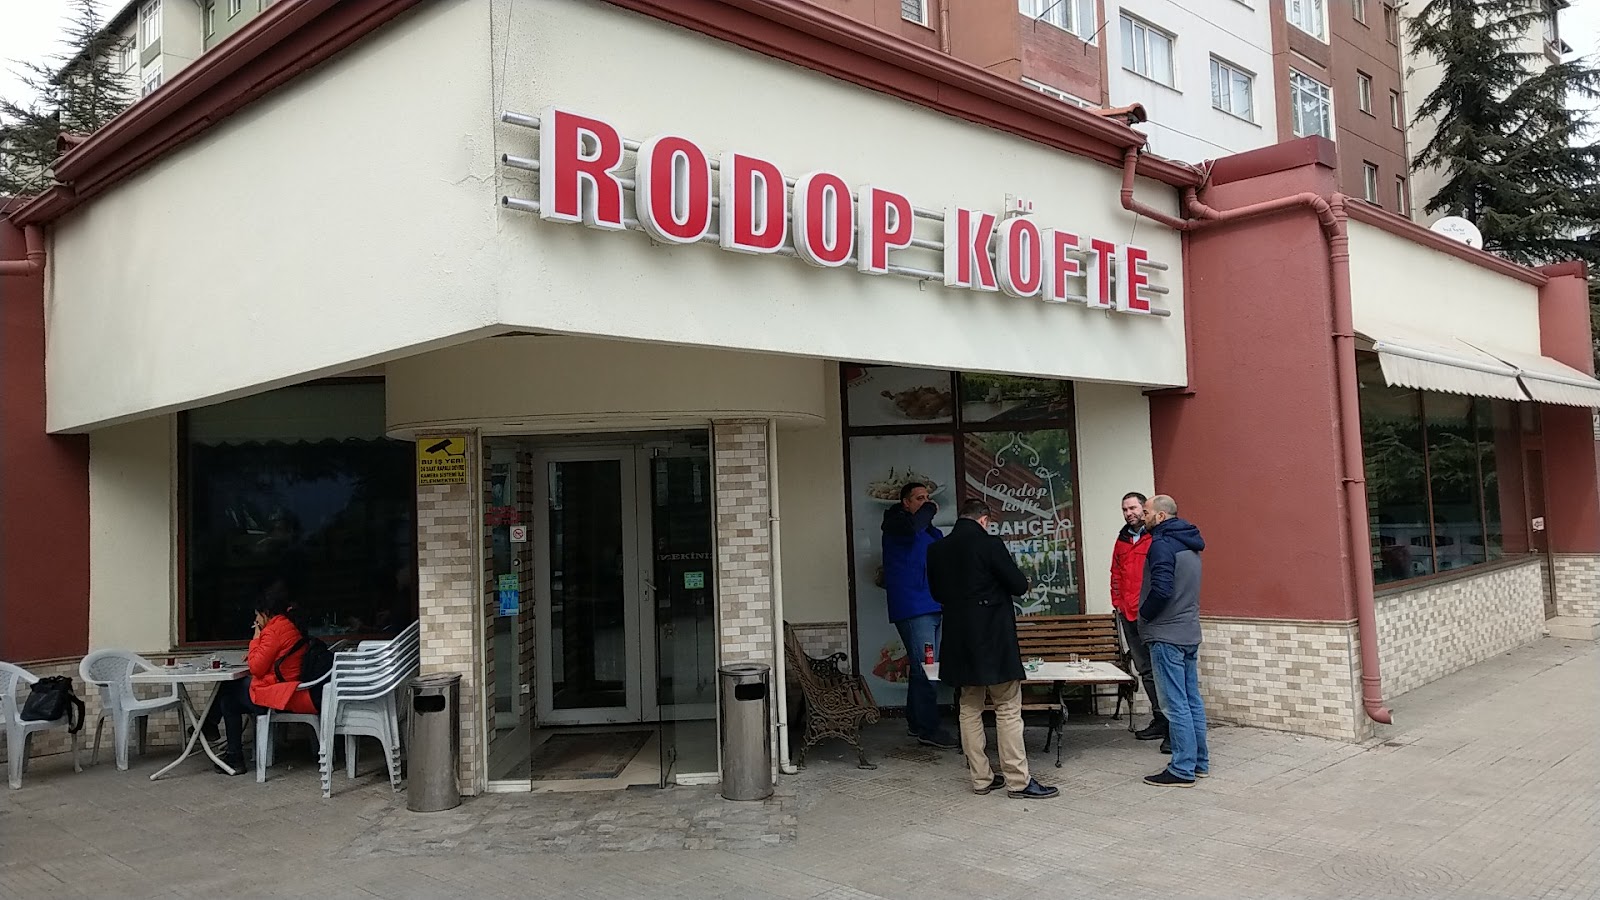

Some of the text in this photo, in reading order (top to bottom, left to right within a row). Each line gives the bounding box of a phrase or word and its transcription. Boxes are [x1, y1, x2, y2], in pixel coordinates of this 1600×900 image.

[540, 106, 1153, 314] RODOP KÖFTE
[992, 483, 1048, 499] Rodop
[988, 520, 1055, 536] BAHÇE
